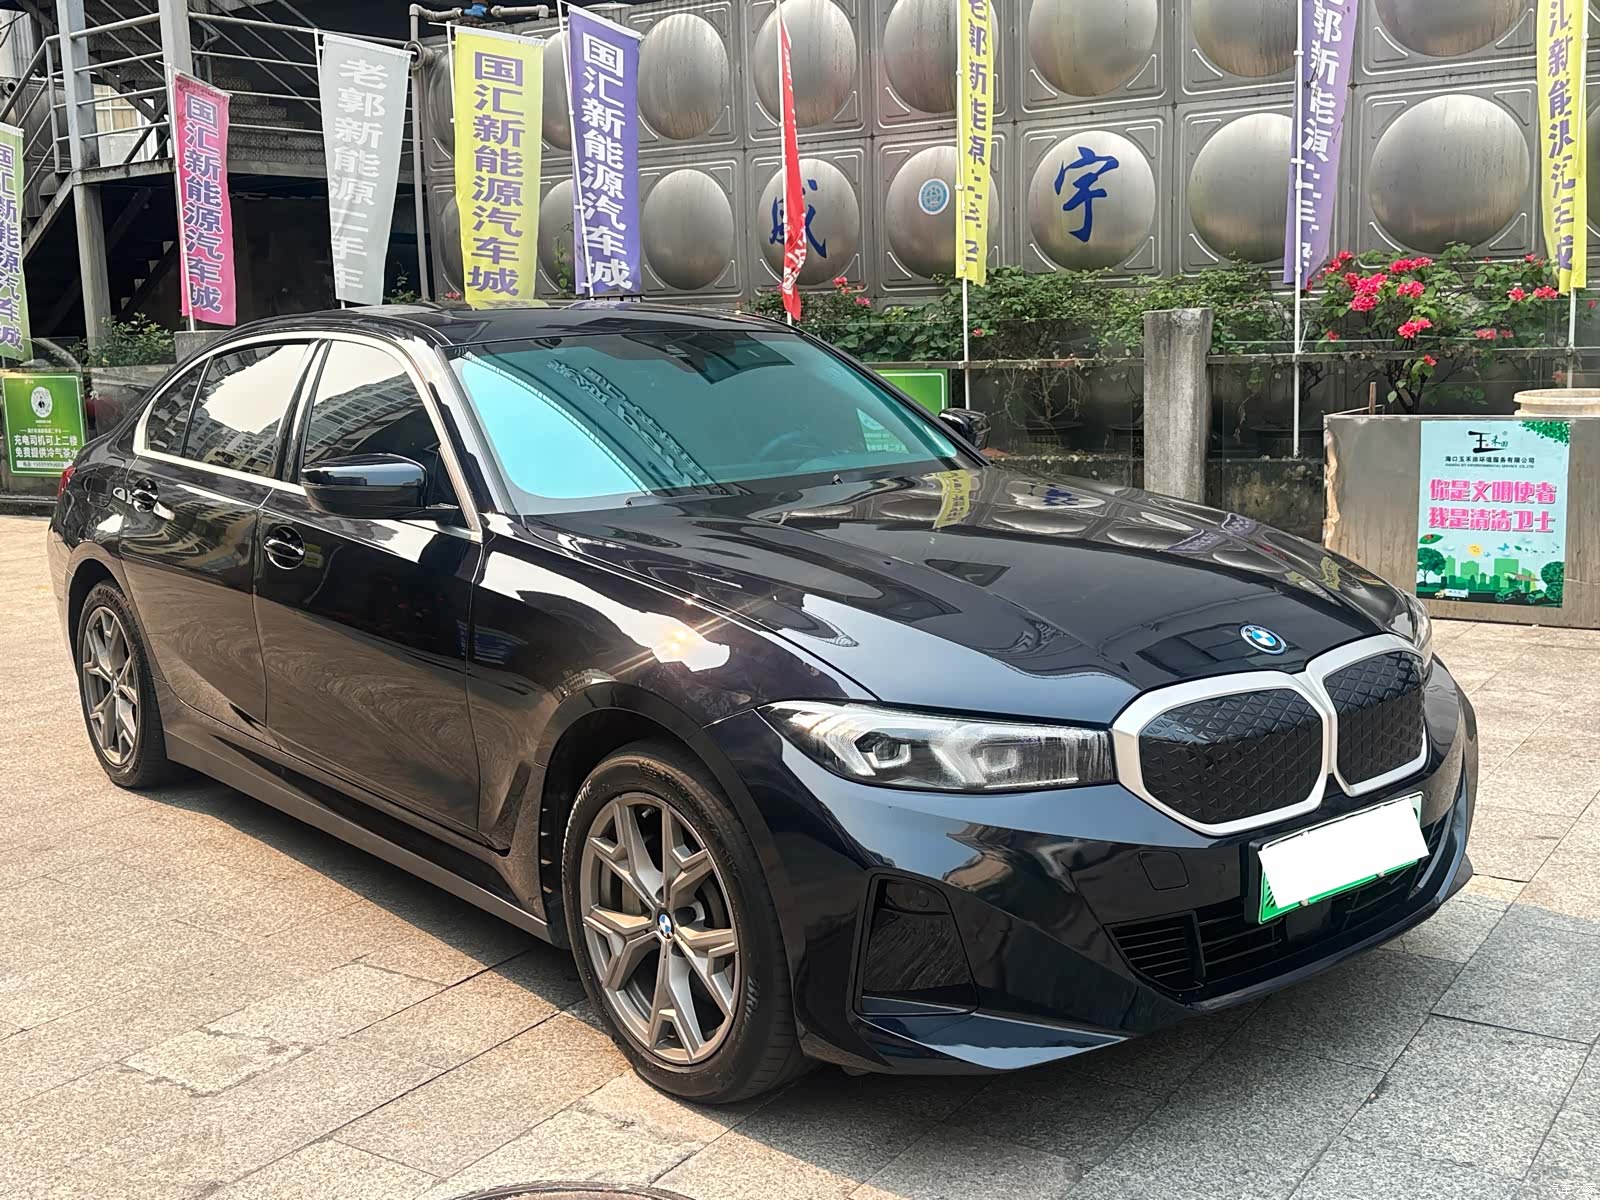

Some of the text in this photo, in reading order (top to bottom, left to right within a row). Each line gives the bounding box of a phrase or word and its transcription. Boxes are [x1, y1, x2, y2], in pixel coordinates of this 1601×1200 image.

[184, 94, 224, 313] 国汇新能源汽车城
[329, 58, 389, 290] 老郭新能源二手车
[466, 52, 526, 296] 国汇新能源汽车城
[581, 31, 634, 290] 国汇新能源汽车城
[1054, 146, 1119, 243] 宇
[14, 435, 78, 446] 充电司机可上二楼
[15, 447, 79, 459] 免费提供冷气茶水
[1429, 506, 1556, 533] 我是清洁卫士
[1430, 479, 1557, 504] 你是文明使者
